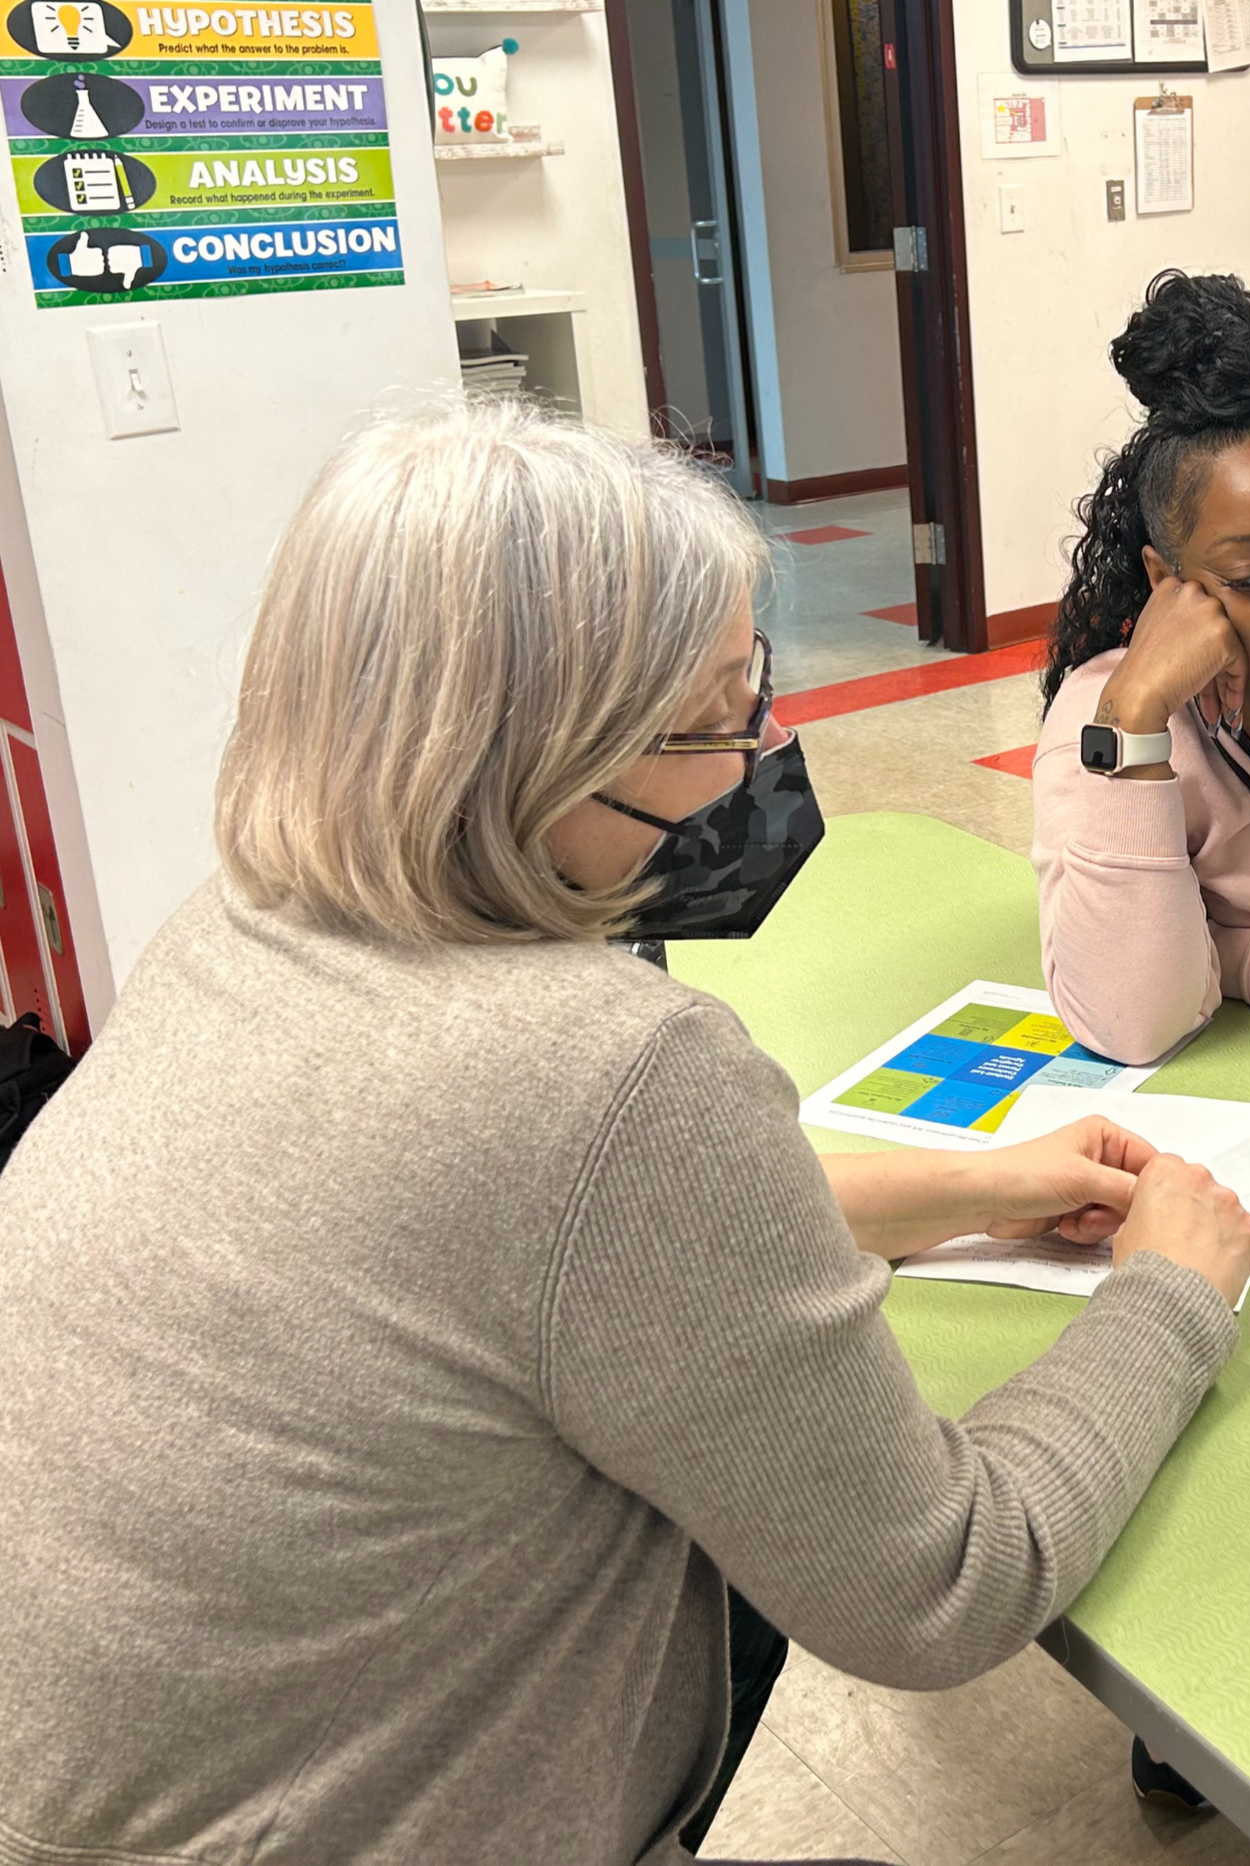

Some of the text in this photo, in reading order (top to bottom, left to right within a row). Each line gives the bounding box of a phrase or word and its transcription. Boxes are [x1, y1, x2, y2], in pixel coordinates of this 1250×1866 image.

[137, 7, 357, 38] HYPOTHESIS
[158, 42, 350, 55] Predict what the answer to the problem is.
[149, 84, 368, 114] EXPERIMENT
[145, 116, 377, 132] Design a test to confirm or disprove your hypothesis.
[189, 156, 359, 189] ANALYSIS
[169, 187, 375, 205] Record what happened during the experiment.
[172, 226, 397, 264] CONCLUSION
[227, 259, 347, 276] Was my hypothesis correct?
